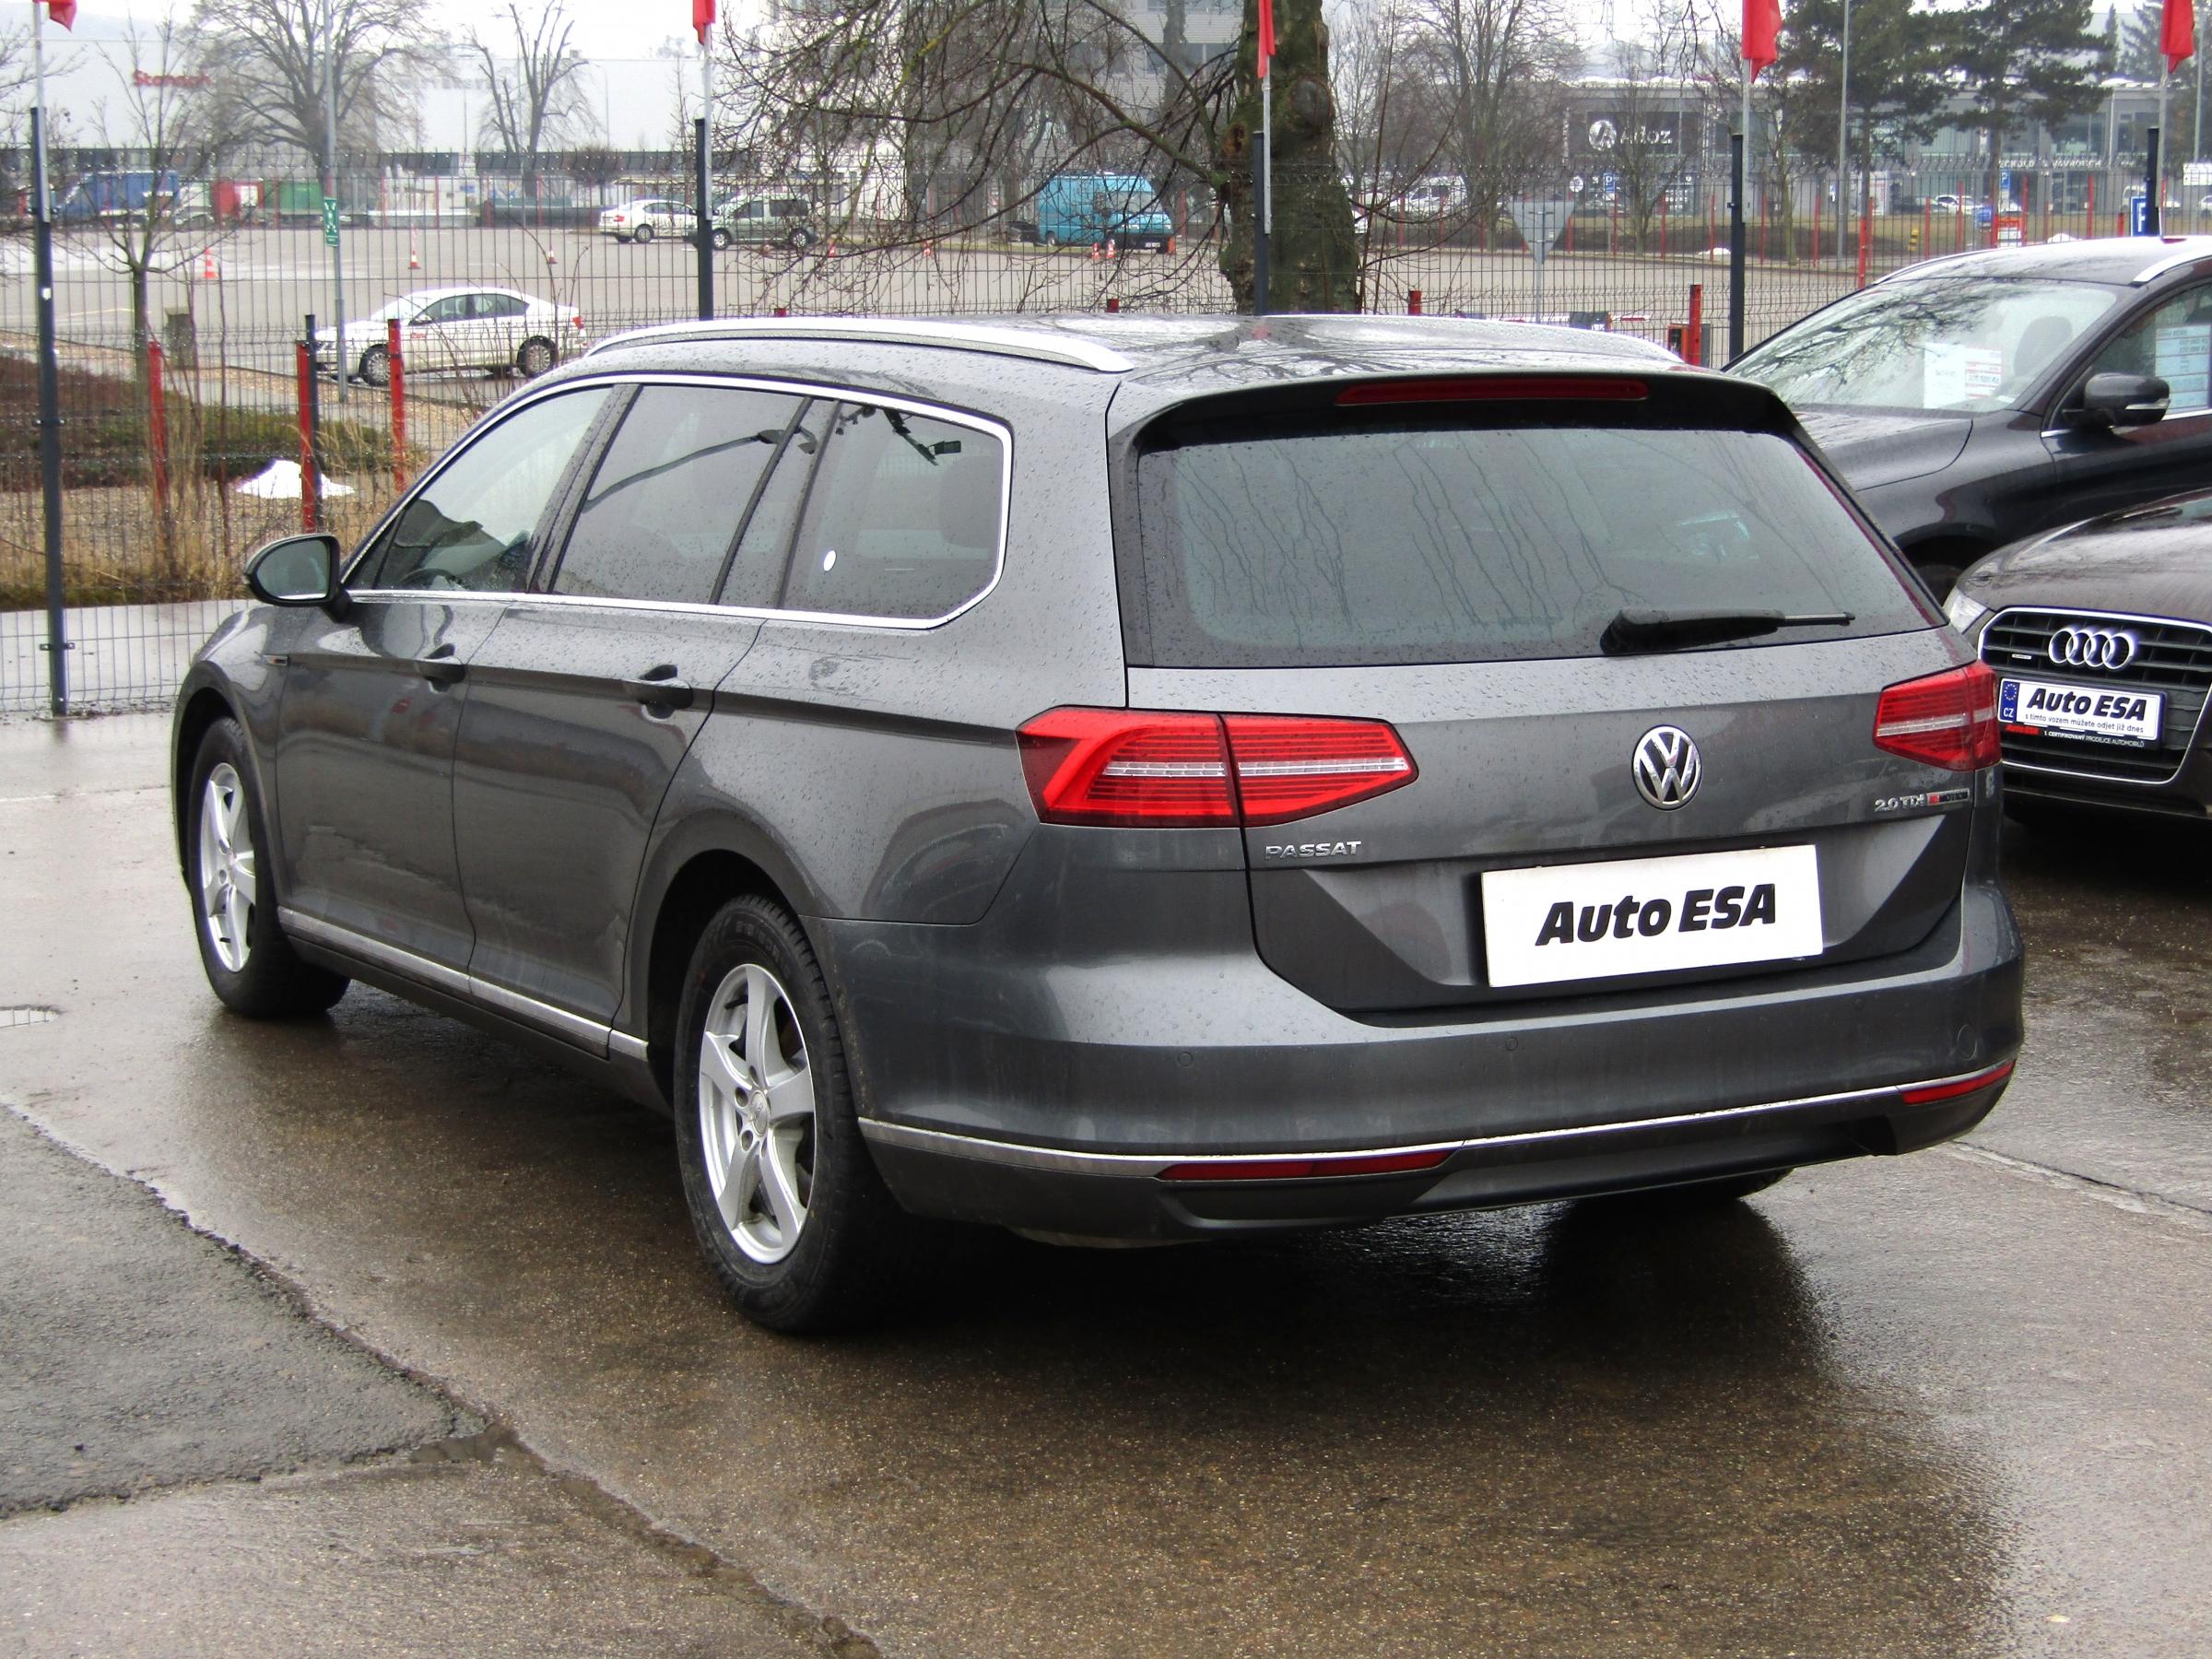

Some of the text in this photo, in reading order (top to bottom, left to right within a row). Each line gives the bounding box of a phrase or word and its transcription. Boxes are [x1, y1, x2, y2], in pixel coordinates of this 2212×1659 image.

[2003, 708, 2014, 718] CZ
[2027, 688, 2147, 721] Auto ESA
[2048, 716, 2069, 724] vozem
[2096, 722, 2114, 732] odjet
[2126, 724, 2144, 733] dnes
[1900, 794, 1924, 808] TDI
[1265, 841, 1362, 860] PASSAT
[1535, 883, 1775, 946] Auto ESA
